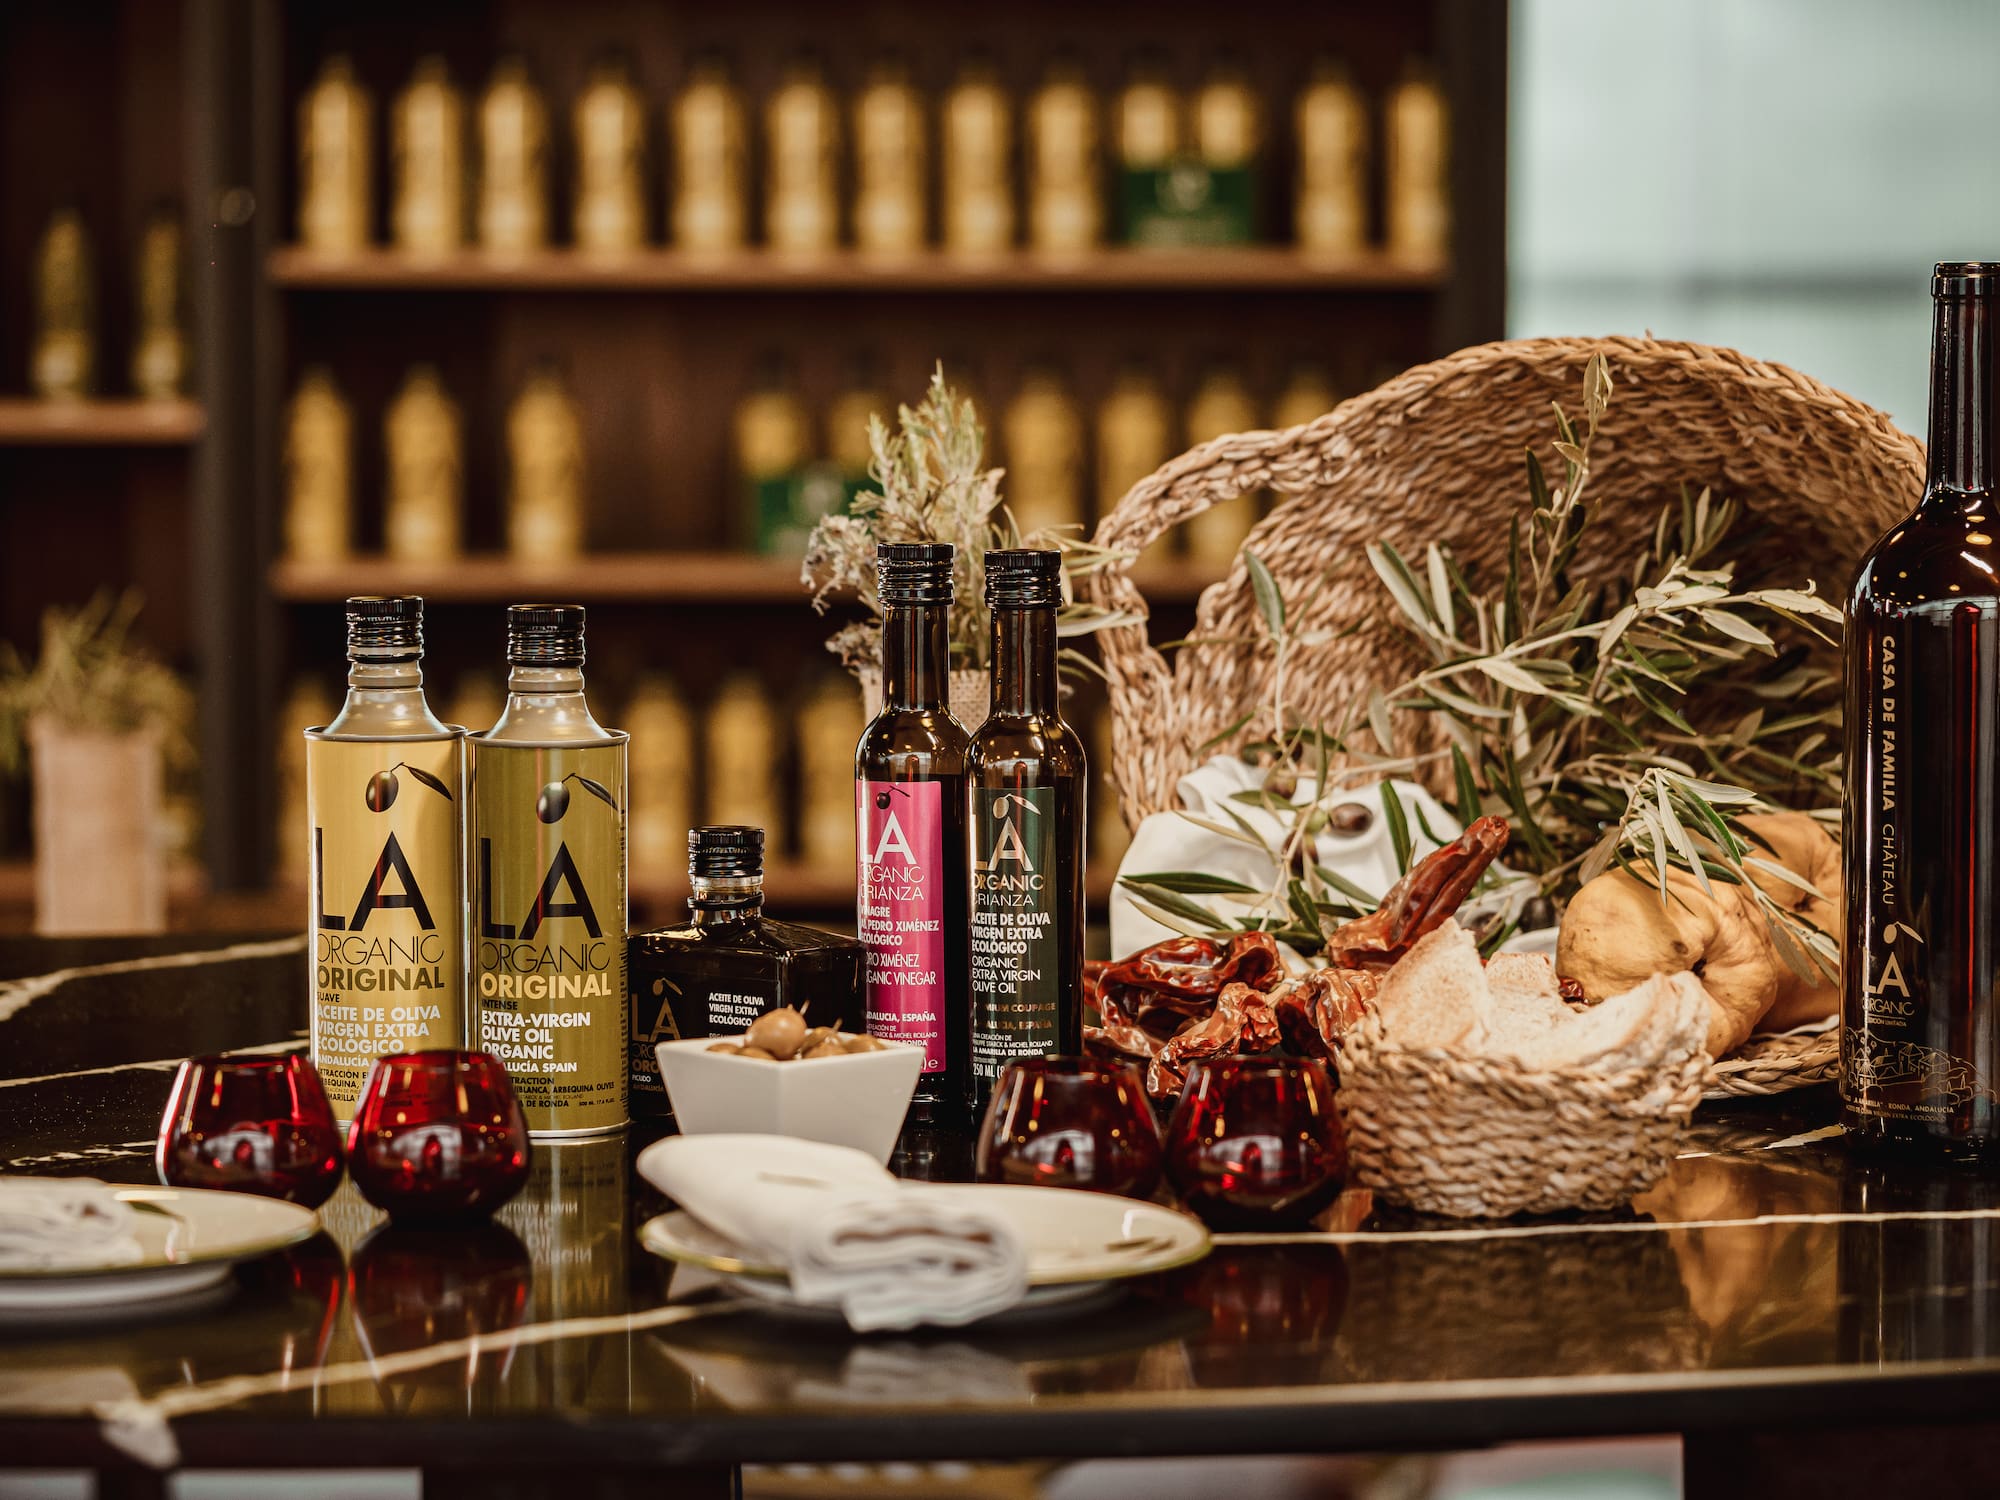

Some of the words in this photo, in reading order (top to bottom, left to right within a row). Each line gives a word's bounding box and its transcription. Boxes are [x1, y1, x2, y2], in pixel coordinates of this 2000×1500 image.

[1882, 636, 1896, 690] CASA
[1882, 698, 1896, 722] DE
[1882, 730, 1896, 811] FAMILIA
[1882, 823, 1898, 905] CHÂTEAU
[315, 827, 436, 931] LA
[972, 873, 1044, 891] ORGANIC
[480, 837, 603, 940] LA
[868, 919, 893, 932] PEDRO
[895, 918, 940, 932] XIMÉNEZ
[971, 911, 997, 925] ACEITE
[999, 913, 1014, 926] DE
[1016, 912, 1051, 926] OLIVA
[971, 925, 1004, 939] VIRGEN
[1006, 926, 1043, 940] EXTRA
[317, 933, 445, 966] ORGANIC
[971, 937, 1027, 954] ECOLÓGICO
[481, 941, 611, 973] ORGANIC
[880, 950, 920, 968] XIMÉNEZ
[971, 955, 1019, 969] ORGANIC
[317, 966, 446, 992] ORIGINAL
[894, 970, 937, 986] VINEGAR
[972, 968, 998, 981] EXTRA
[1000, 969, 1041, 982] VIRGIN
[480, 972, 611, 1000] ORIGINAL
[972, 980, 996, 993] OLIVE
[998, 982, 1017, 994] OIL
[482, 998, 518, 1011] INTENSE
[708, 992, 731, 1003] ACEITE
[732, 994, 742, 1005] DE
[743, 996, 765, 1007] OLIVA
[317, 1005, 358, 1020] ACEITE
[363, 1007, 385, 1022] DE
[390, 1005, 441, 1022] OLIVA
[631, 993, 681, 1042] LA
[708, 1003, 733, 1015] VIRGEN
[734, 1005, 759, 1017] EXTRA
[902, 1009, 937, 1022] ESPAÑA
[481, 1010, 591, 1028] EXTRA-VIRGIN
[317, 1022, 368, 1037] VIRGEN
[374, 1022, 430, 1037] EXTRA
[481, 1025, 520, 1042] OLIVE
[524, 1028, 554, 1043] OIL
[317, 1035, 404, 1054] ECOLÓGICO
[481, 1041, 553, 1059] ORGANIC
[1007, 1048, 1016, 1056] DE
[542, 1061, 577, 1073] SPAIN
[973, 1063, 983, 1077] 250
[538, 1100, 569, 1108] RONDA
